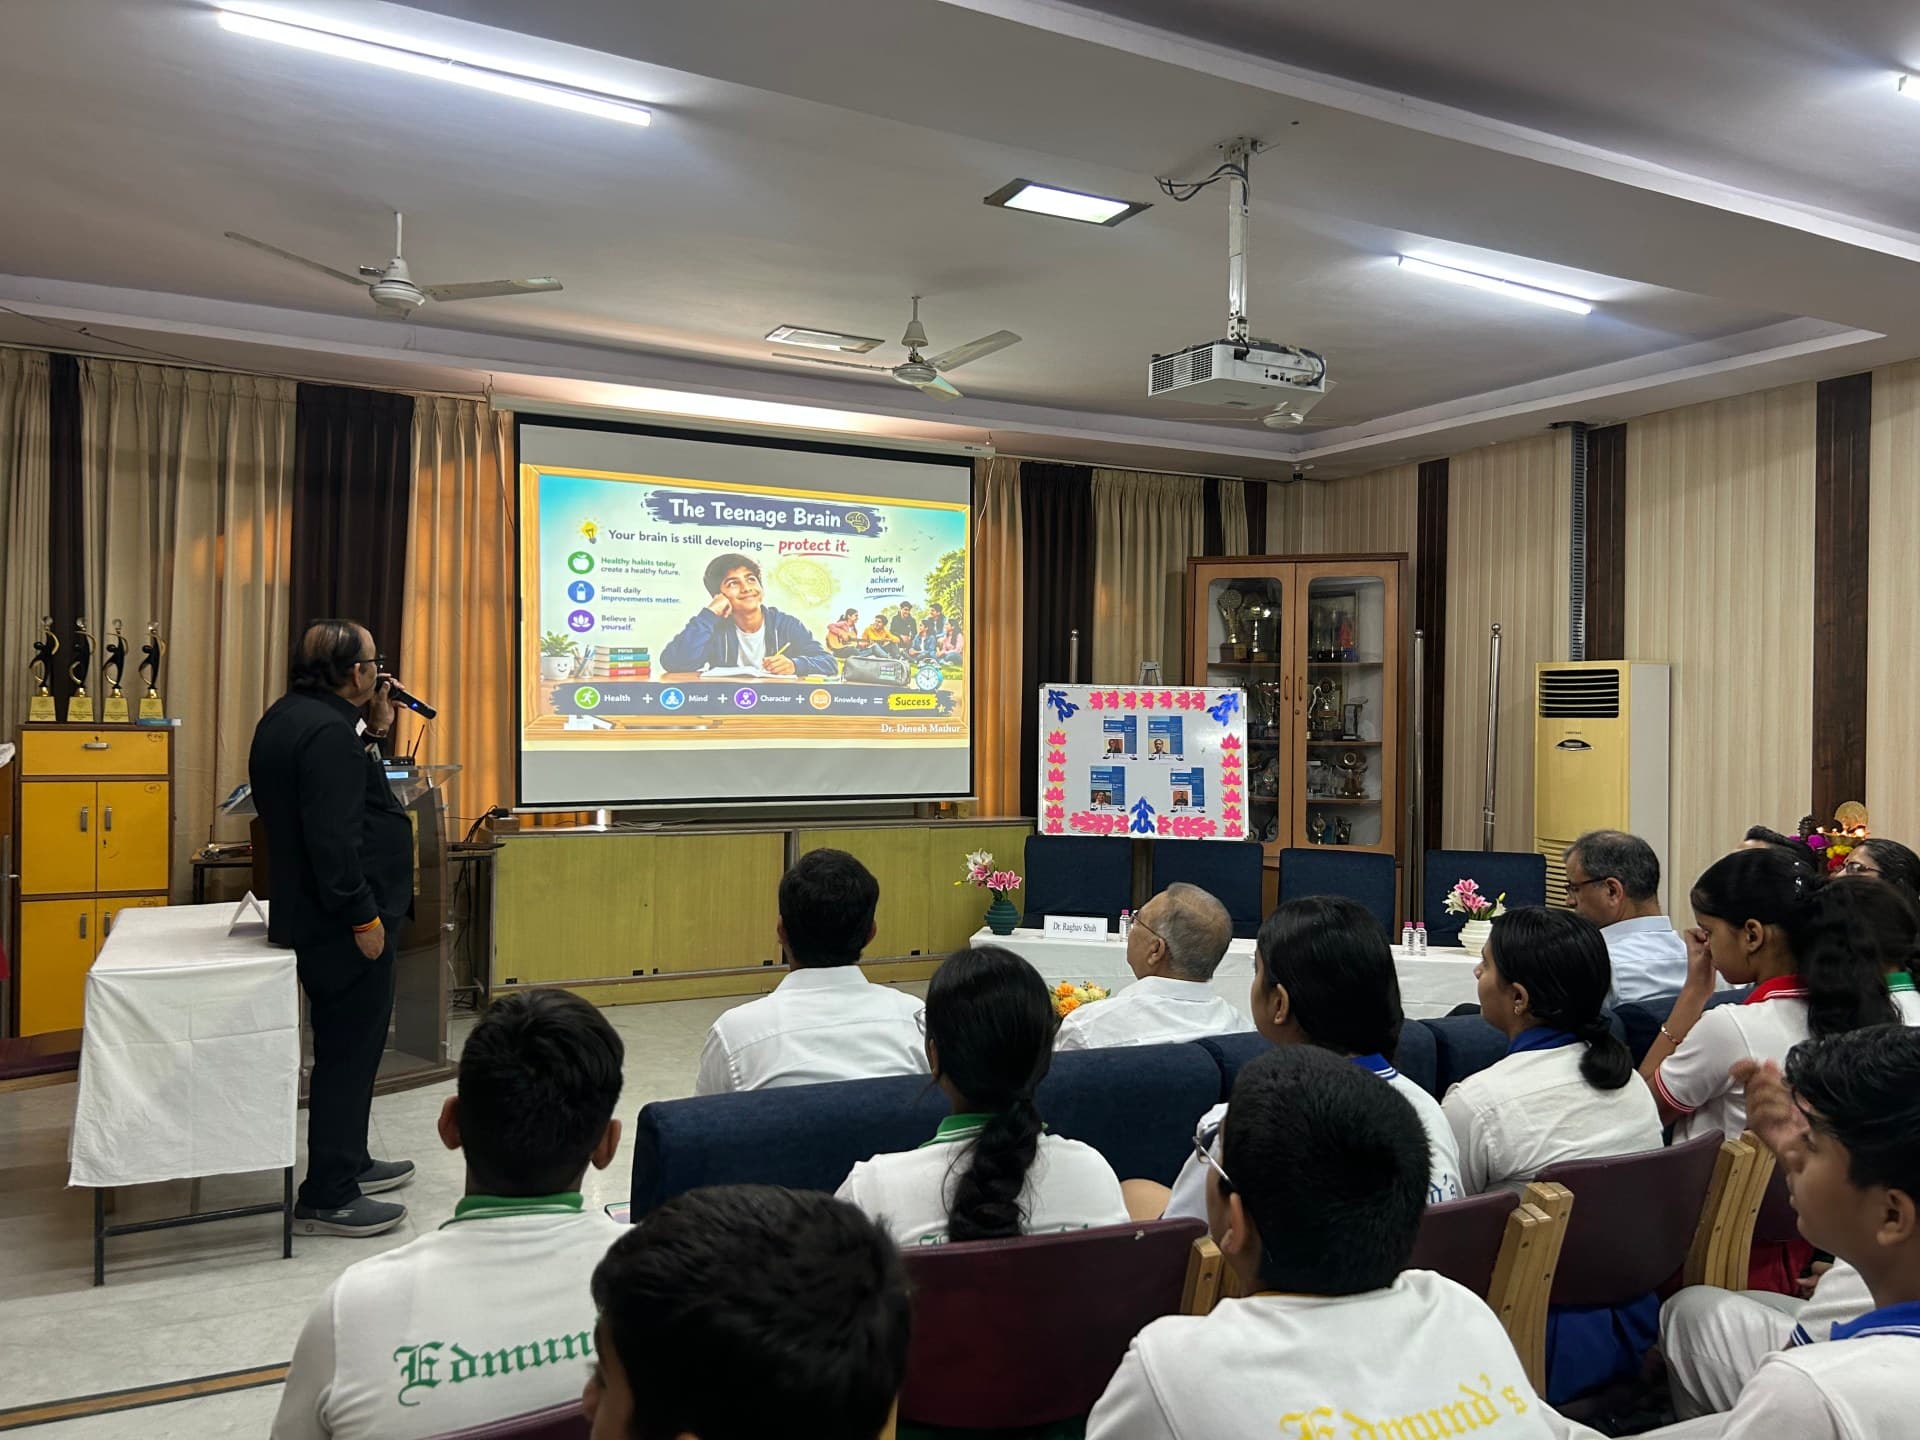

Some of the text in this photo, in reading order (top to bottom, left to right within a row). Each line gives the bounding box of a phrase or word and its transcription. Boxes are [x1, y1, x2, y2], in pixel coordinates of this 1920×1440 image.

[668, 498, 841, 528] The Teenage Brain
[608, 529, 635, 541] Your
[639, 531, 668, 543] brain
[671, 532, 680, 544] is
[682, 533, 702, 545] still
[778, 538, 831, 555] protect
[835, 540, 850, 553] it.
[601, 557, 676, 568] Healthy habits today
[864, 555, 901, 564] Nurture it
[631, 566, 656, 576] healthy
[658, 568, 681, 576] future.
[872, 564, 895, 575] today,
[870, 575, 898, 584] achieve
[623, 587, 641, 595] daily
[865, 584, 905, 594] tomorrow!
[601, 595, 653, 603] improvements
[601, 624, 633, 632] yourself.
[604, 694, 631, 702] Health
[689, 694, 709, 702] Mind
[760, 694, 791, 703] Character
[834, 695, 868, 705] Knowledge
[895, 697, 931, 706] Success
[881, 723, 895, 733] Dr.
[896, 723, 927, 733] Dinesh
[393, 1331, 593, 1406] Edmun
